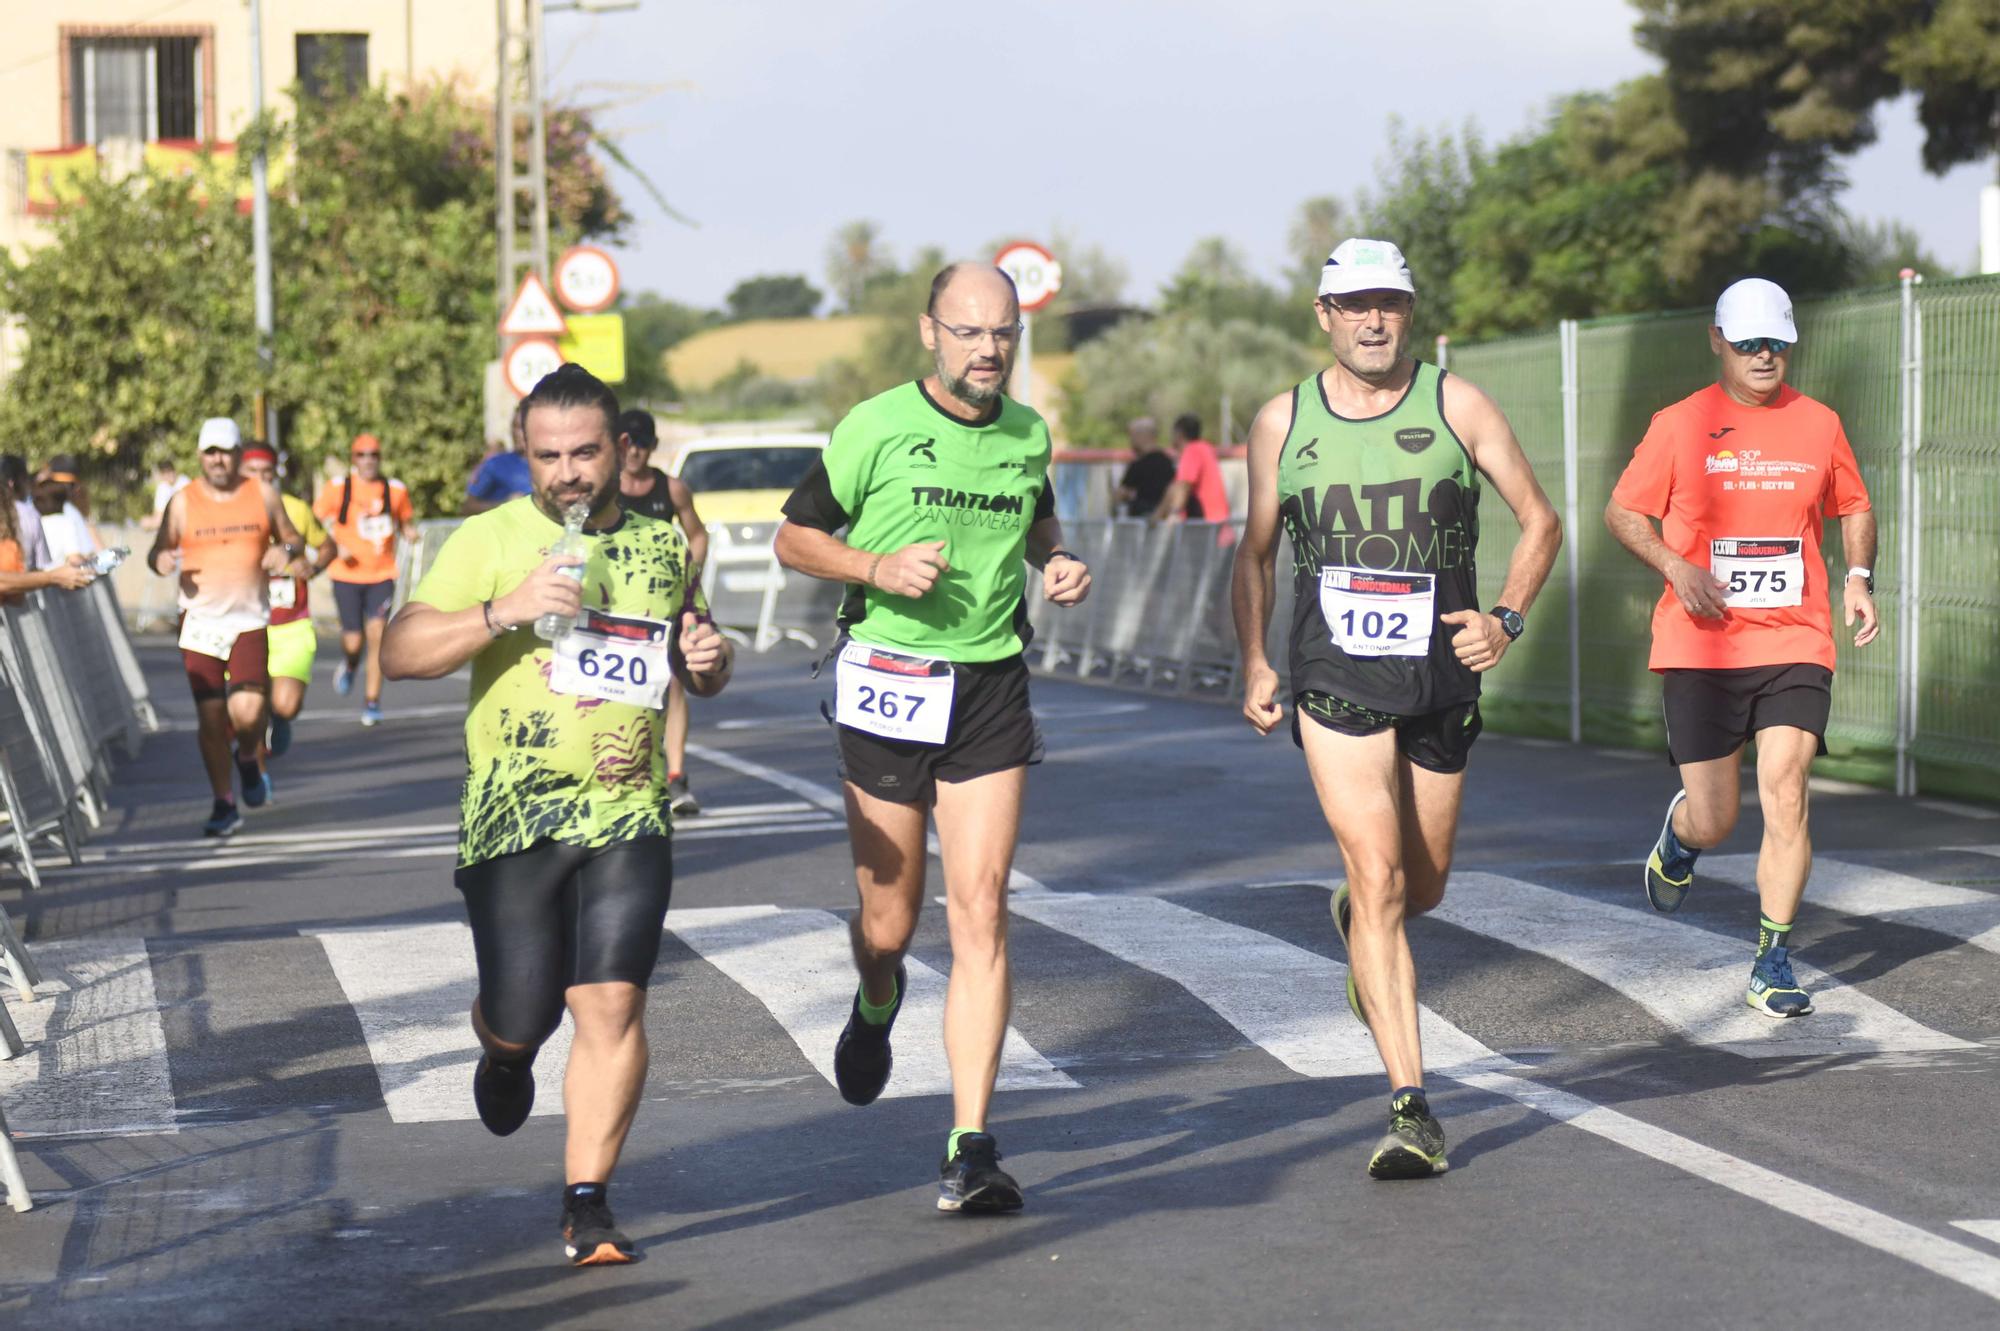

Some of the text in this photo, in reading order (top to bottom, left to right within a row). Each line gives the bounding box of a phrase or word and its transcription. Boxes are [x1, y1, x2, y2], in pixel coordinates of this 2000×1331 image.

[1723, 481, 1735, 490] SOL
[911, 487, 1024, 515] TRIATLÓN
[913, 507, 1021, 531] SANTOMERA
[1714, 540, 1787, 556] XXVIII NONDUERMAS
[1350, 578, 1412, 594] NONDUERMAS
[1729, 570, 1787, 593] 575
[1341, 609, 1409, 640] 102
[579, 648, 648, 686] 620
[858, 685, 926, 722] 267
